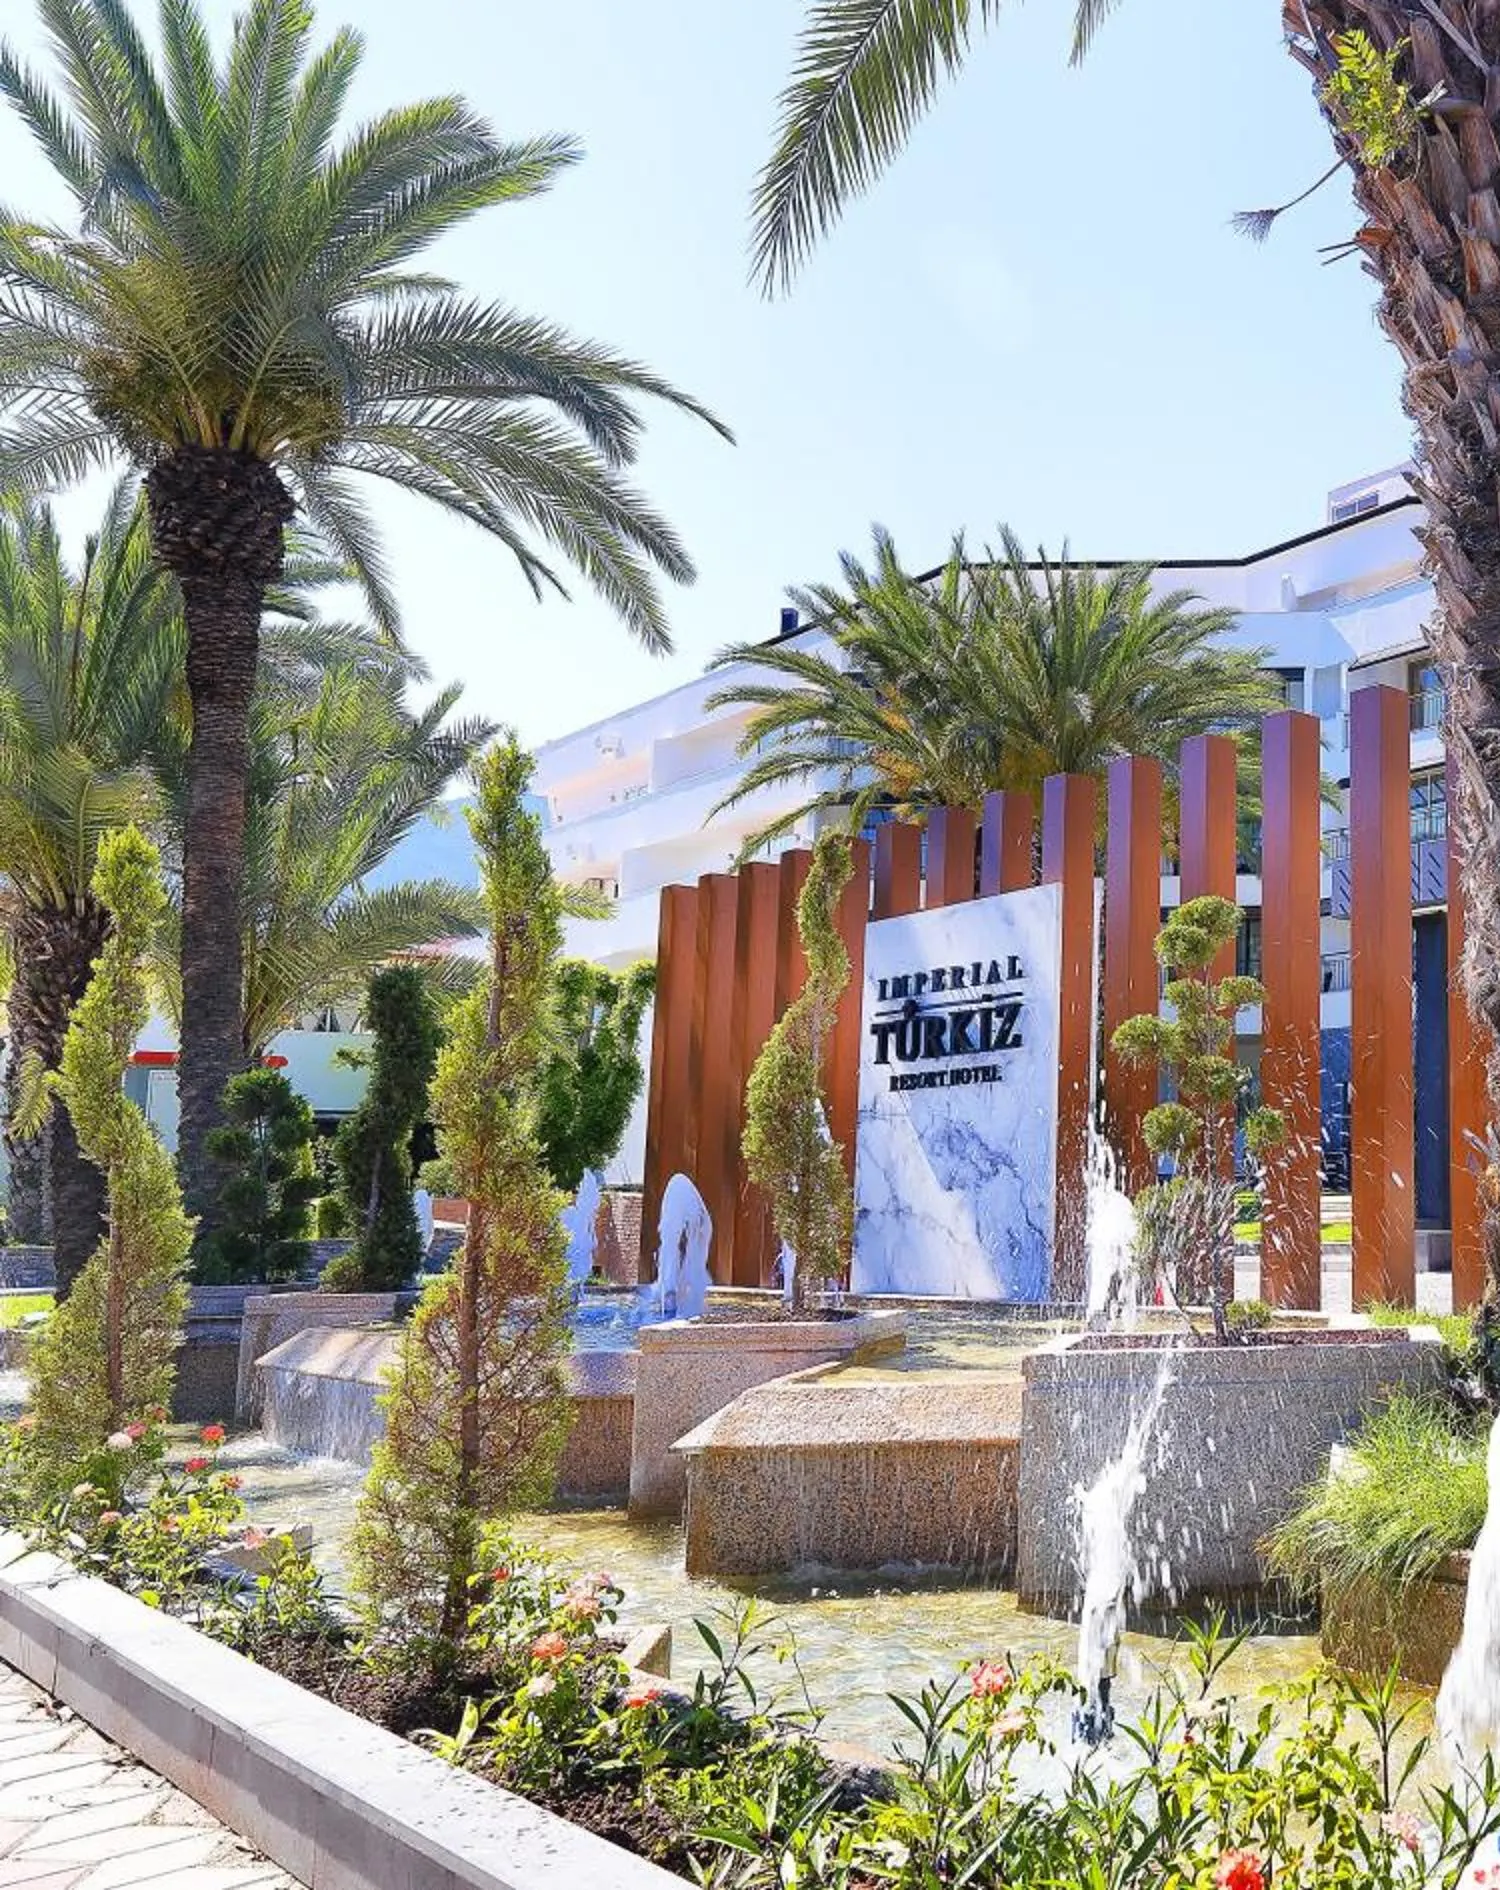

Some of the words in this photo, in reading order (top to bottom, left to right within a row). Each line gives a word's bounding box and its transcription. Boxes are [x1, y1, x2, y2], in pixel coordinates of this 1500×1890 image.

[877, 955, 1024, 1001] IMPERIAL
[889, 1070, 948, 1092] RESORT
[949, 1064, 1003, 1087] HOTEL
